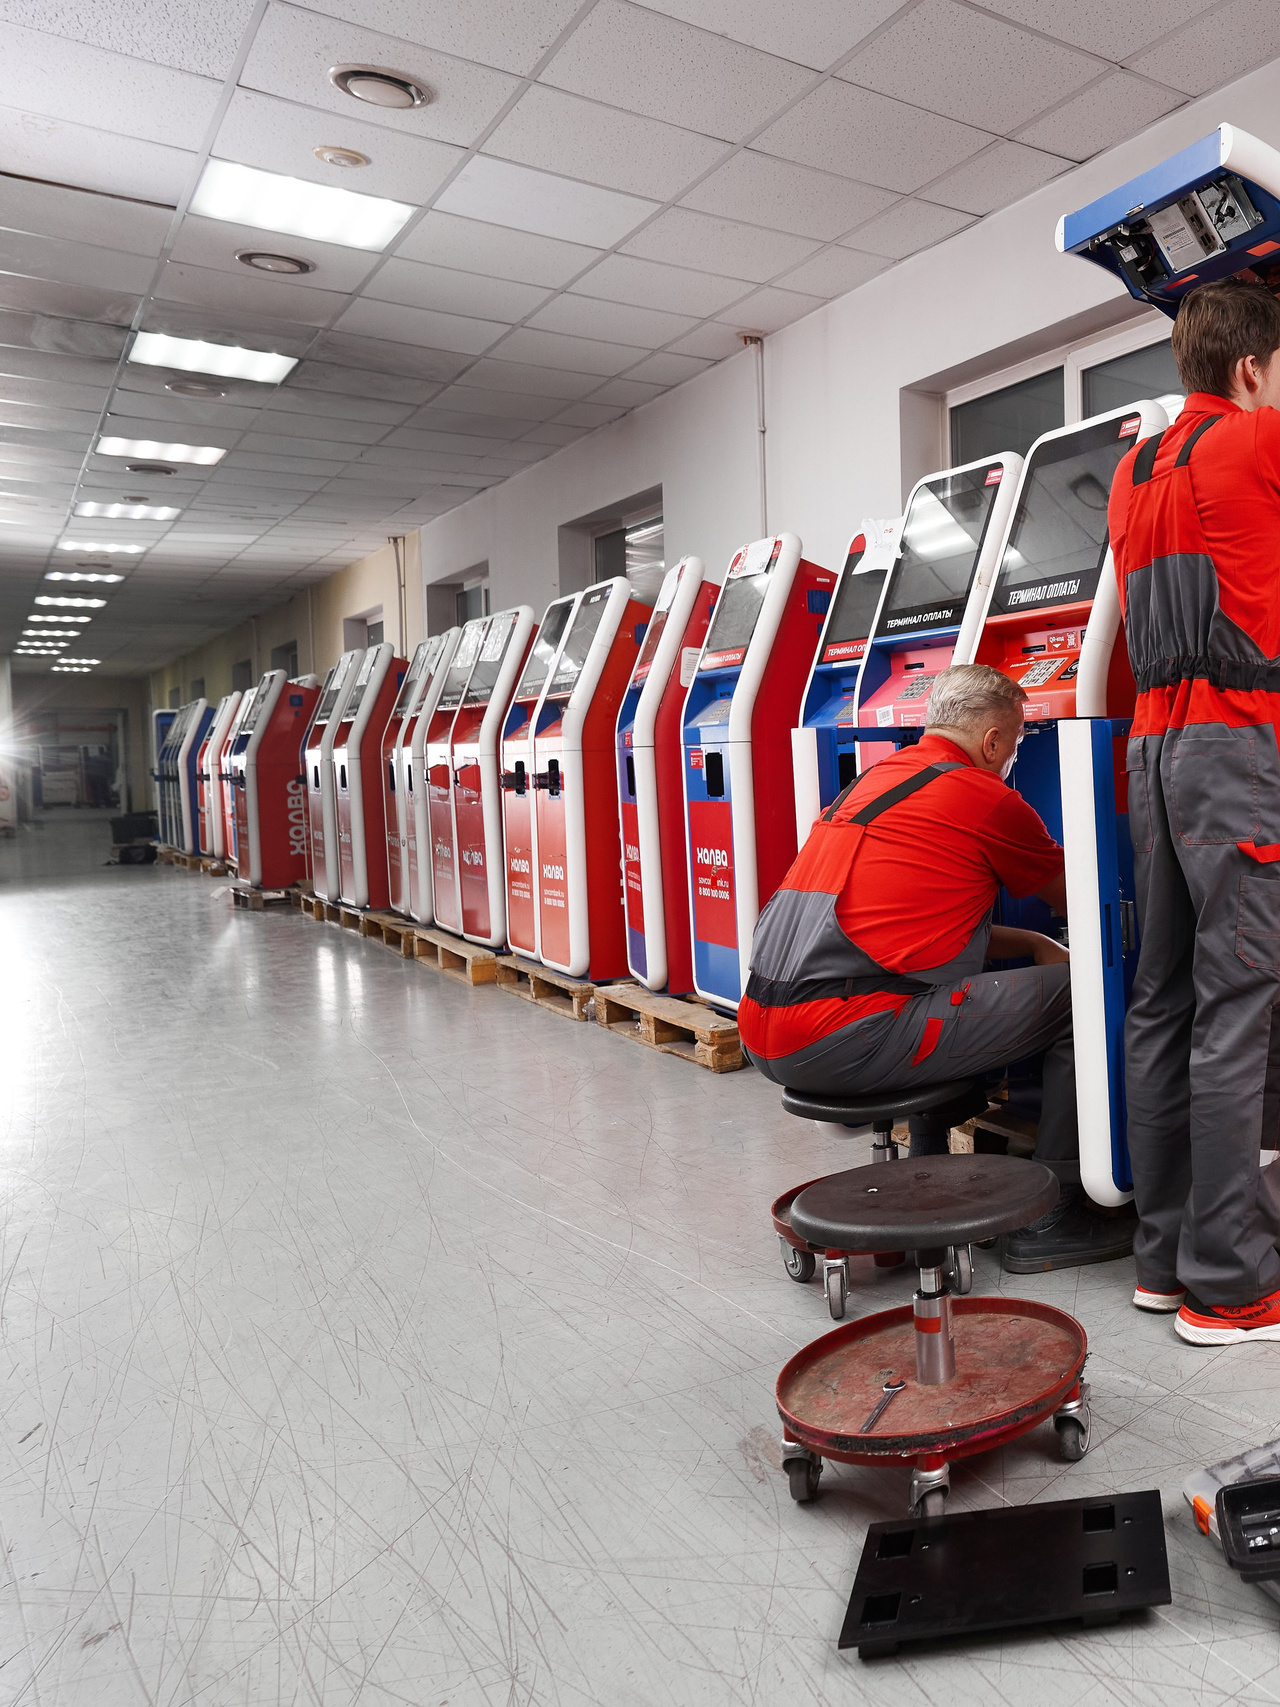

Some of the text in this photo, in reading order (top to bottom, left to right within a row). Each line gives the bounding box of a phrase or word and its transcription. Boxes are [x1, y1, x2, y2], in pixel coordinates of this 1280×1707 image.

[1007, 579, 1081, 606] ТЕРМИНАЛ ОПЛАТЫ
[886, 609, 953, 628] ТЕРМИНАЛ ОПЛАТЫ
